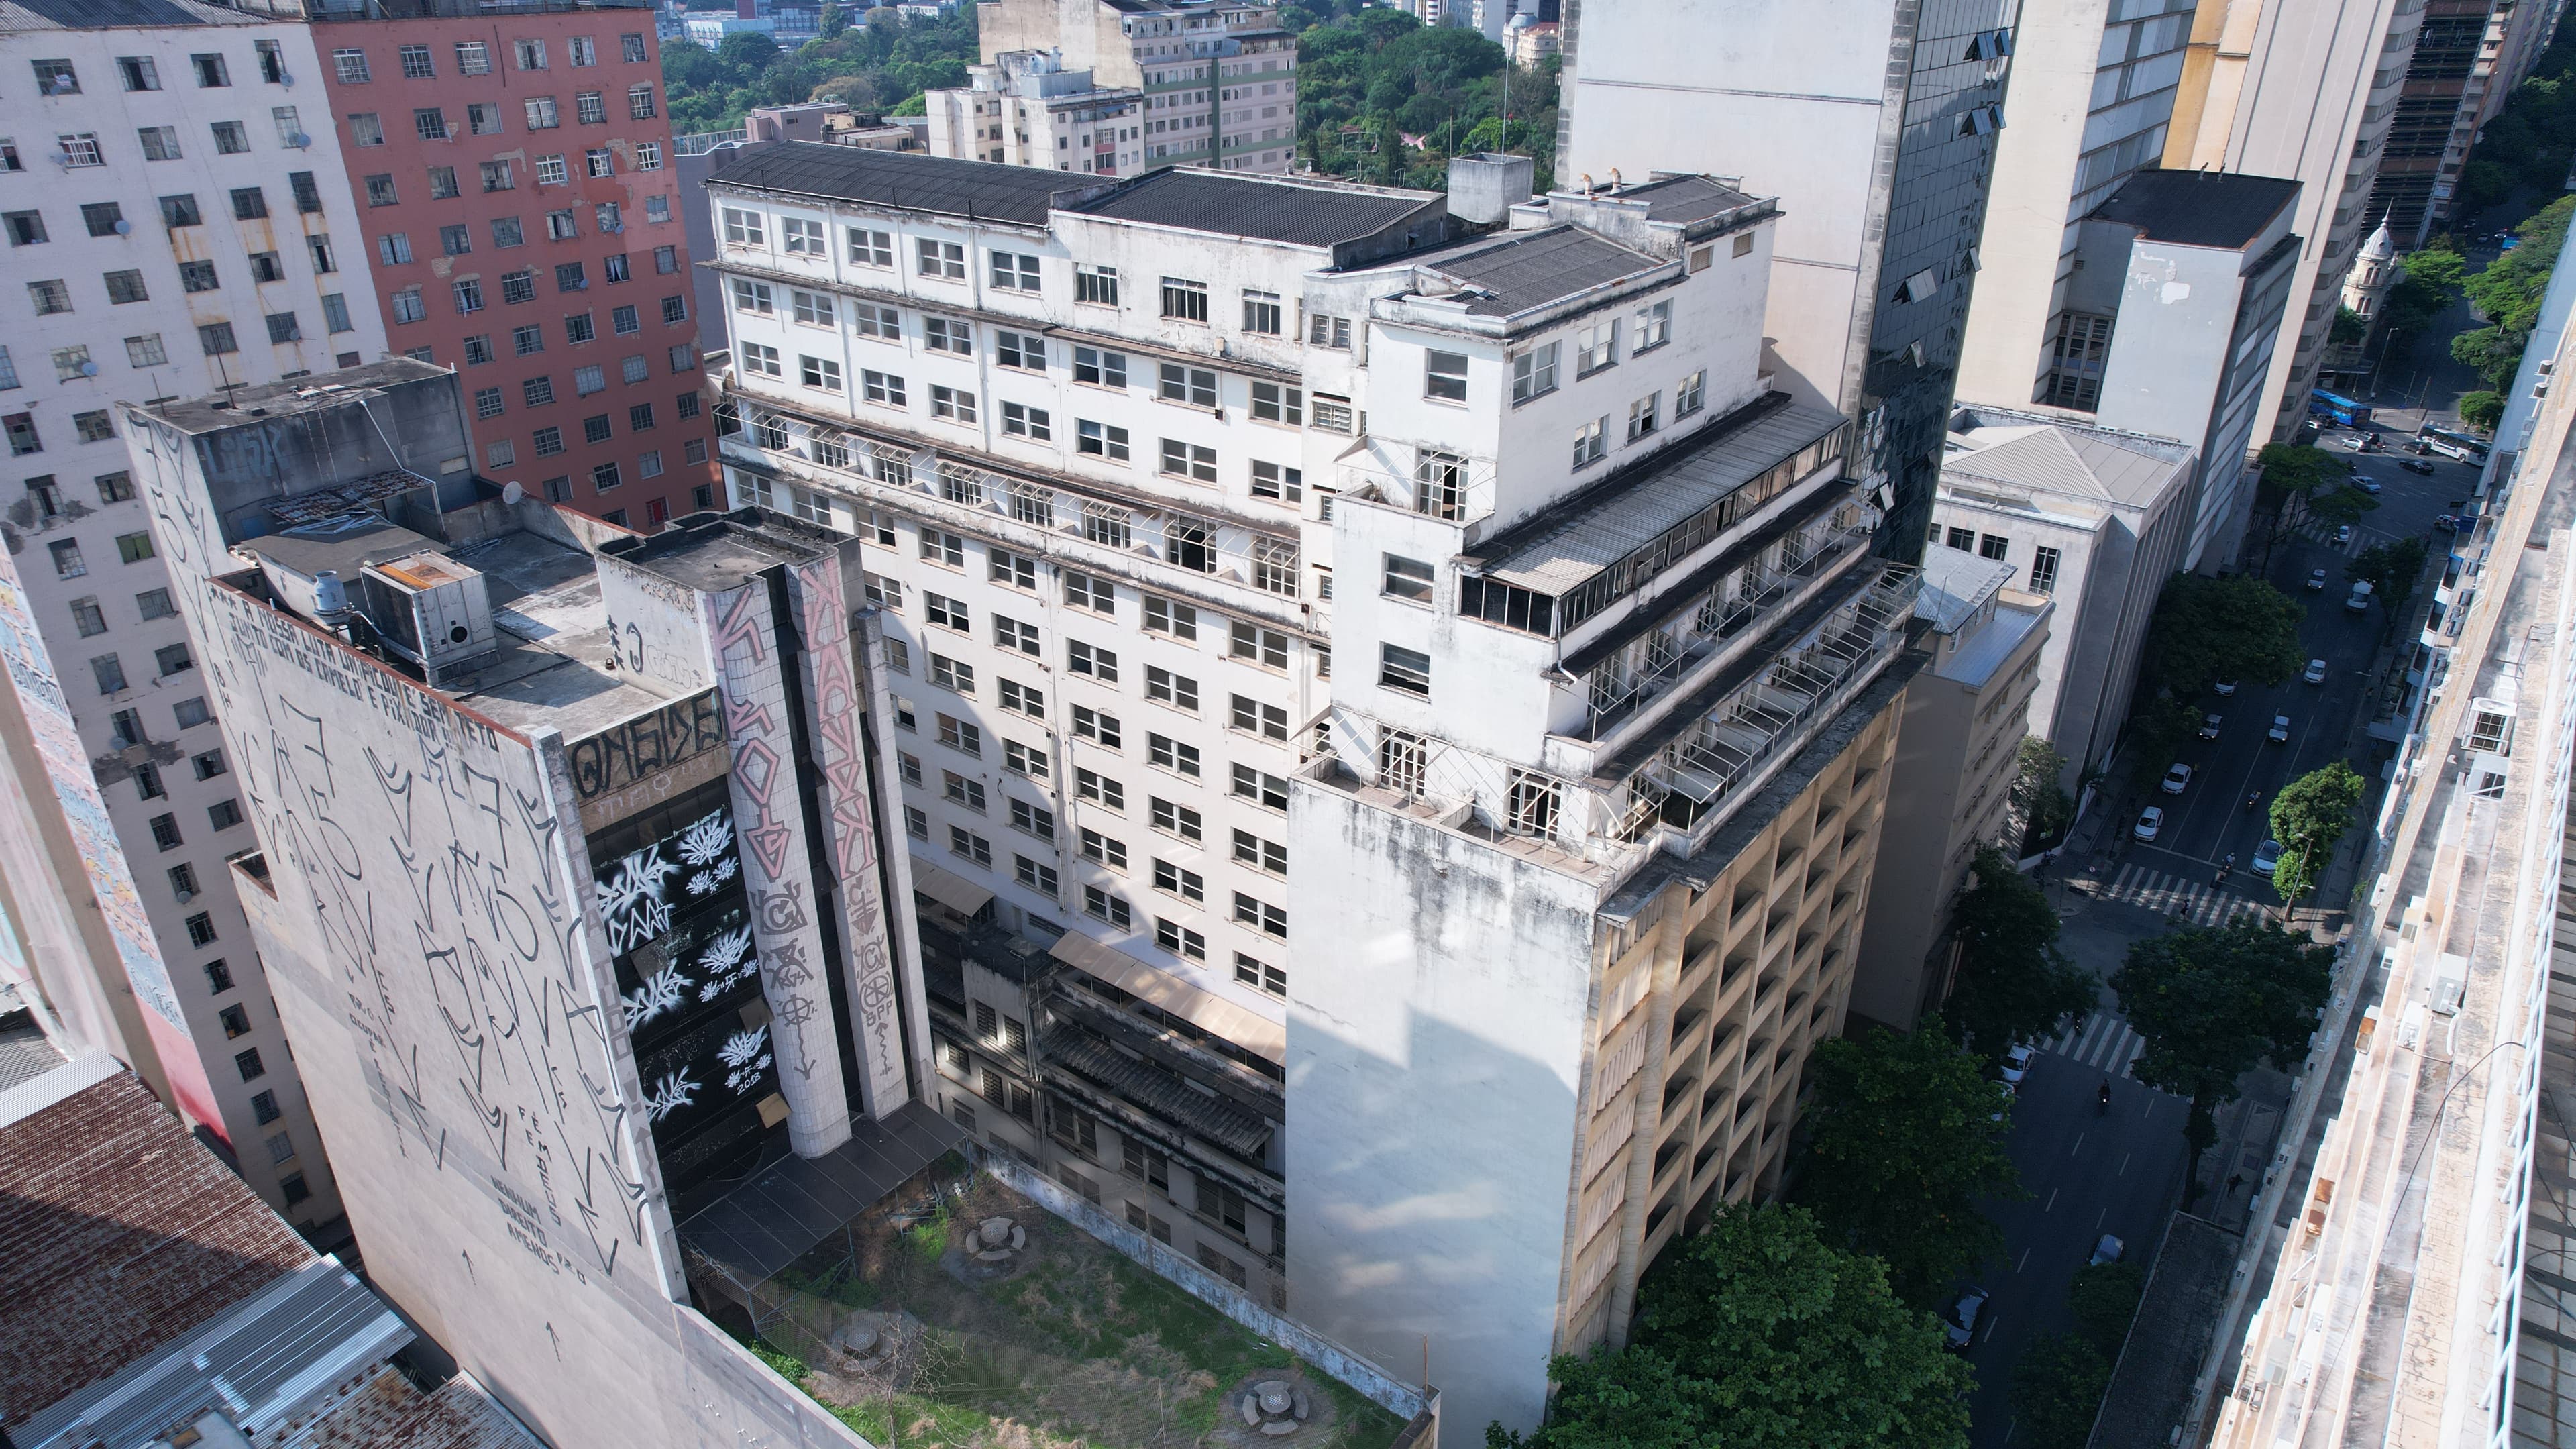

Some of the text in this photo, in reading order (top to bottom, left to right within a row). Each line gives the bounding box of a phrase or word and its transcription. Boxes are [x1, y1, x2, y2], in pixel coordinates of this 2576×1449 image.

[229, 611, 268, 649] JUNTO
[268, 633, 295, 663] COM
[295, 648, 313, 674] OS
[367, 685, 378, 710] E
[256, 606, 300, 646] NOSSA
[301, 629, 337, 665] LUTA
[453, 708, 500, 753] TETO
[737, 1071, 762, 1096] 2018
[490, 1175, 542, 1226] NENHUM
[498, 1197, 549, 1248] DIREITO
